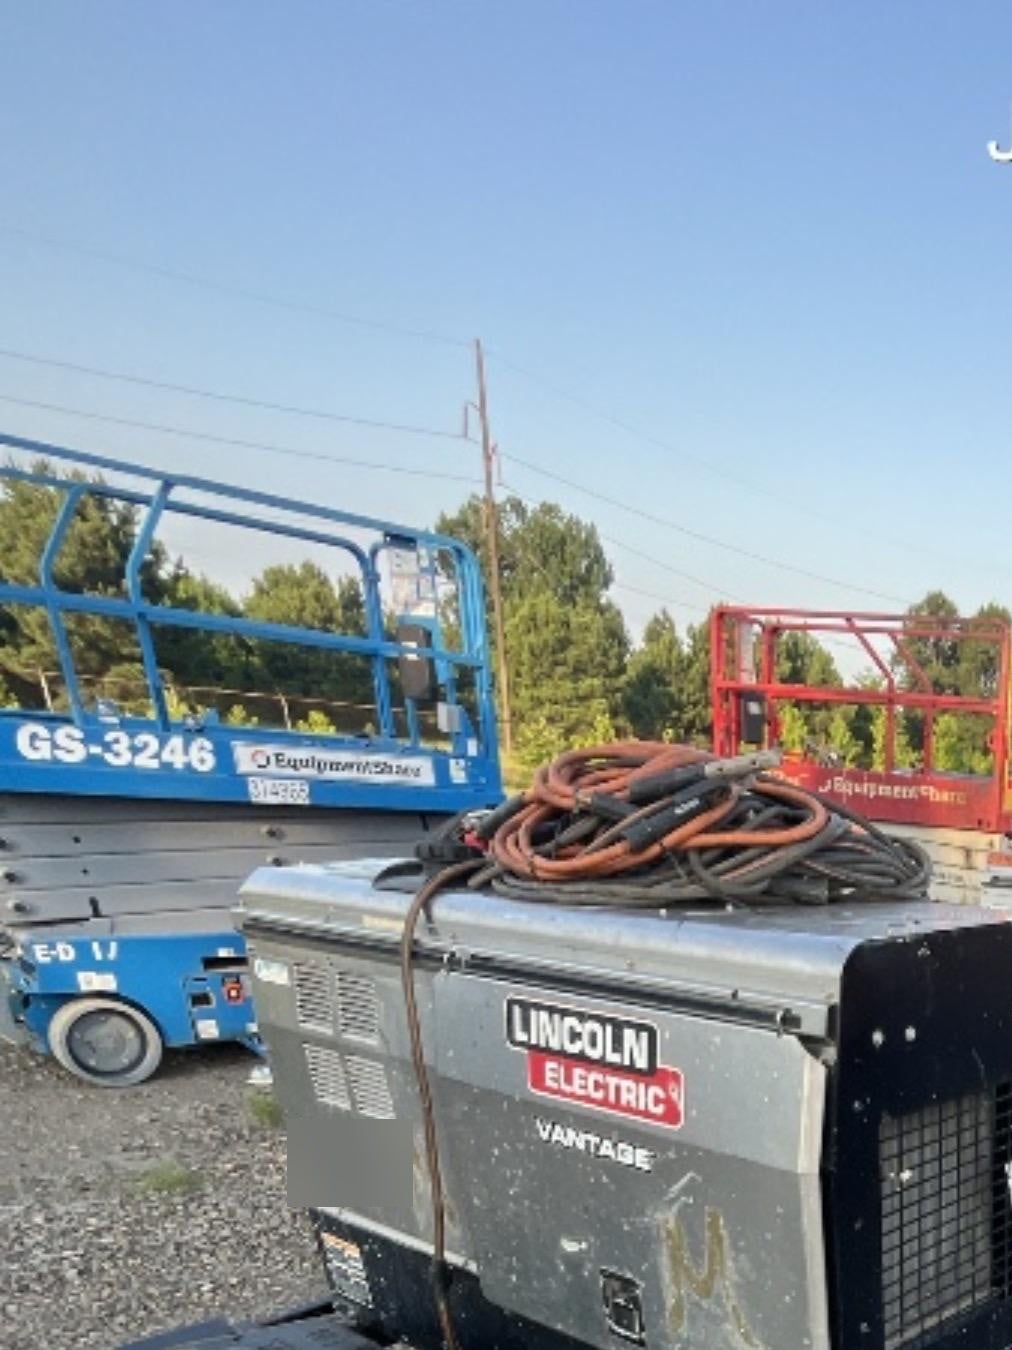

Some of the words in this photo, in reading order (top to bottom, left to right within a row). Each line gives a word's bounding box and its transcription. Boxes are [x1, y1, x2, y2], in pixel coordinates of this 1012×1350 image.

[16, 723, 216, 772] GS-3246
[512, 1004, 649, 1071] LINCOLN
[544, 1060, 667, 1115] ELECTRIC
[536, 1117, 656, 1172] VANTAGE
